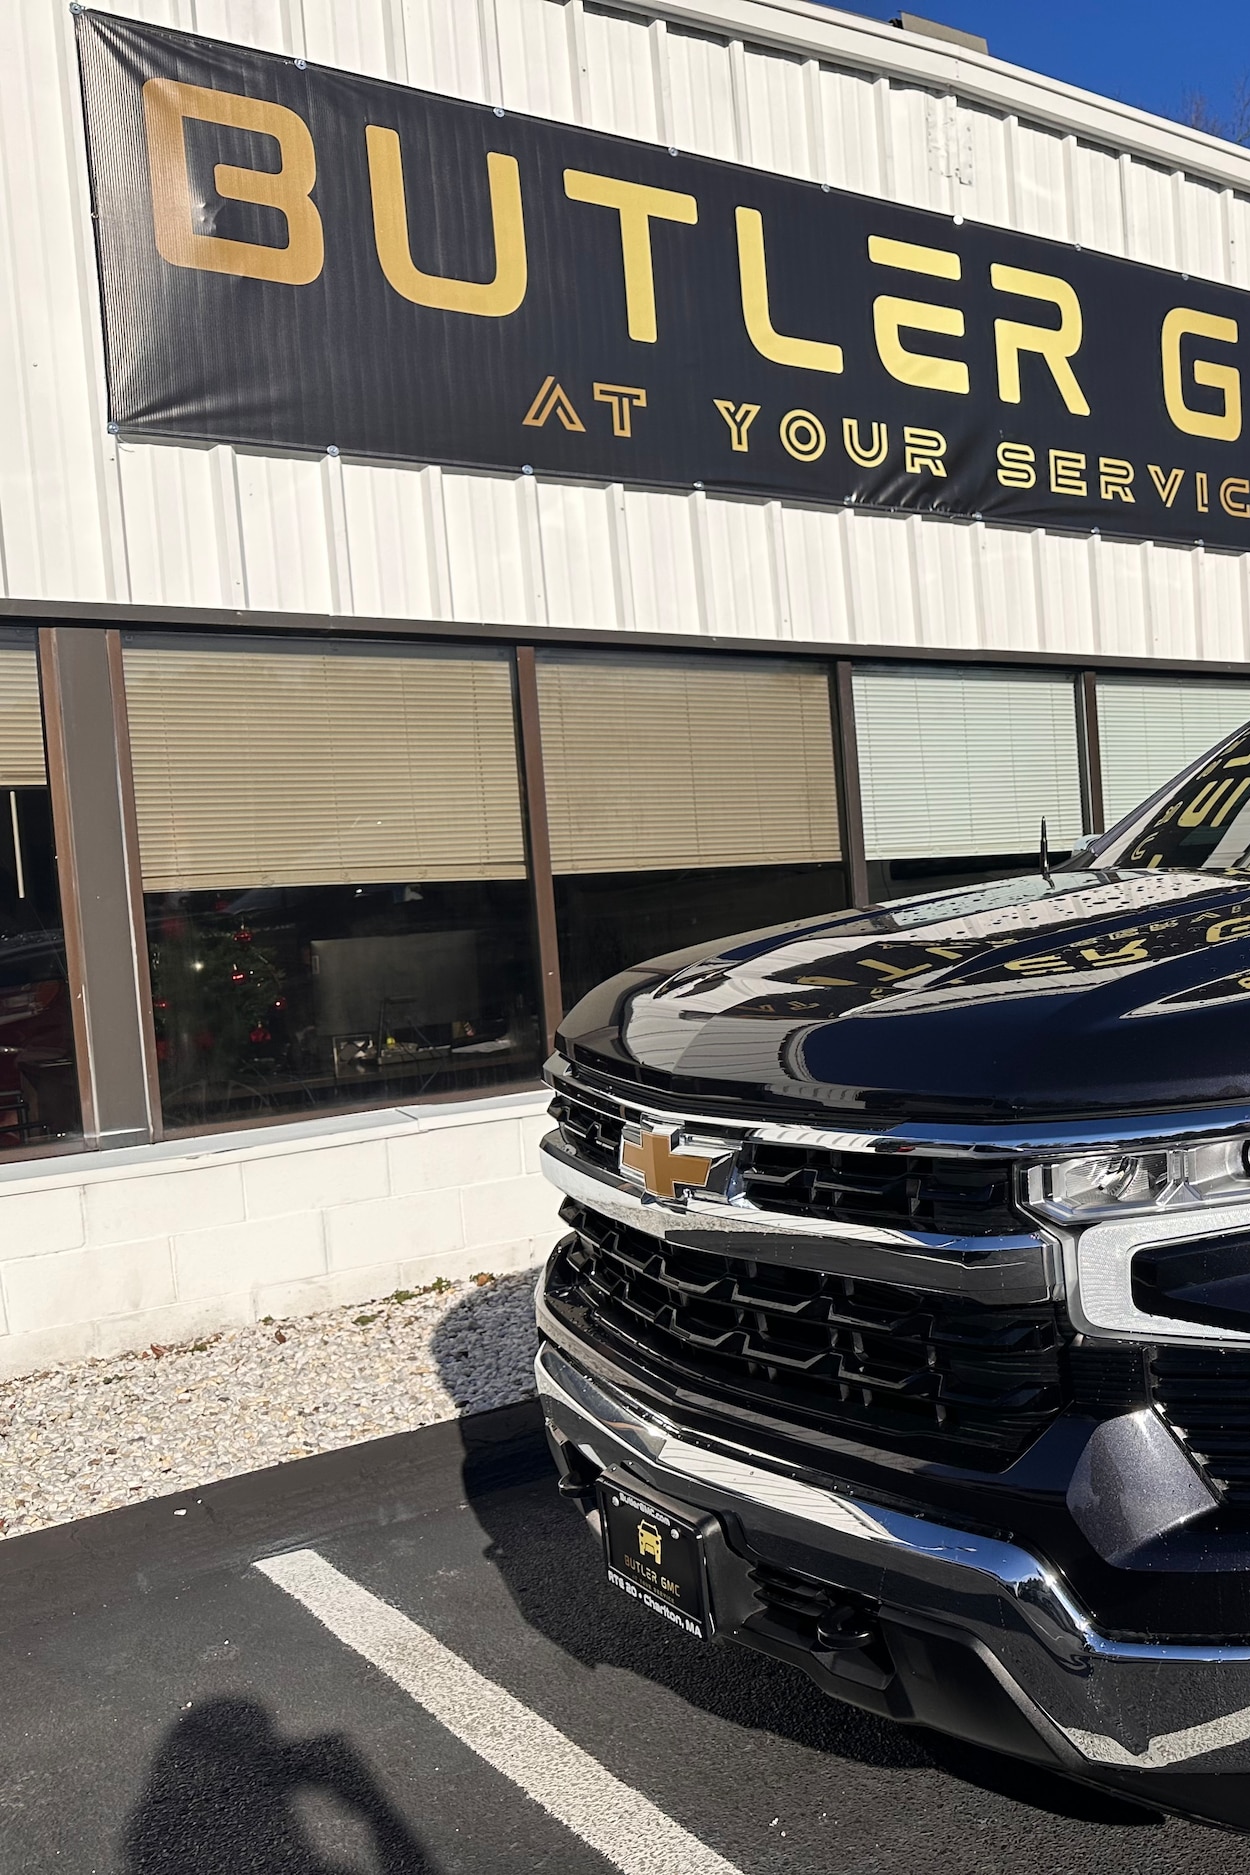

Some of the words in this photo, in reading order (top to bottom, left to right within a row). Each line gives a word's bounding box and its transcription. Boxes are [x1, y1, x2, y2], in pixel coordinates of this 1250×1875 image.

[142, 77, 1090, 417] BUTLER
[522, 375, 647, 438] AT
[714, 399, 948, 478] YOUR
[624, 1554, 658, 1584] BUTLER
[661, 1576, 681, 1598] GMC
[685, 1619, 702, 1639] MA
